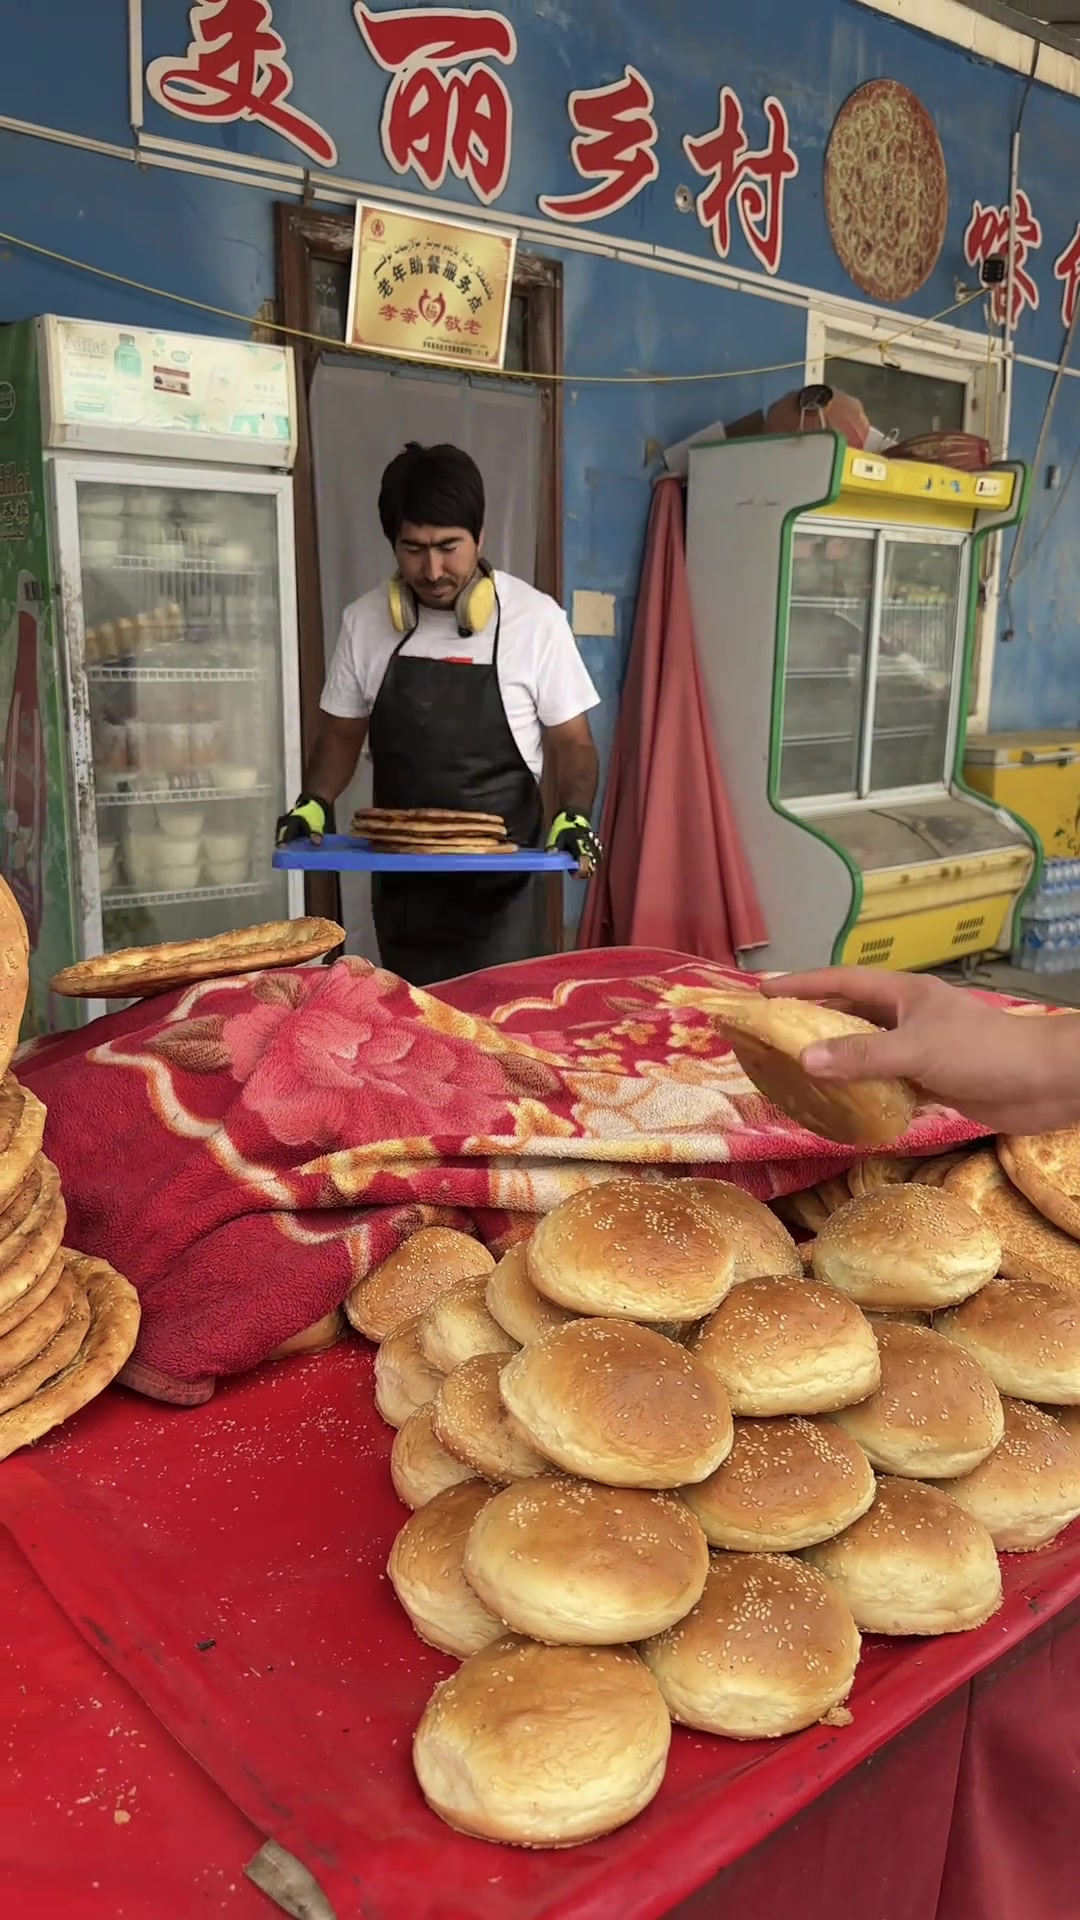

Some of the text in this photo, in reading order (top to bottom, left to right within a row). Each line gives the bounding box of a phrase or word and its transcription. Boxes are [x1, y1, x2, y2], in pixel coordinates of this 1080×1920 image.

[146, 0, 798, 274] 美丽乡村
[376, 254, 484, 314] 老年助餐服务点
[378, 304, 418, 325] 孝亲
[444, 315, 482, 336] 敬老
